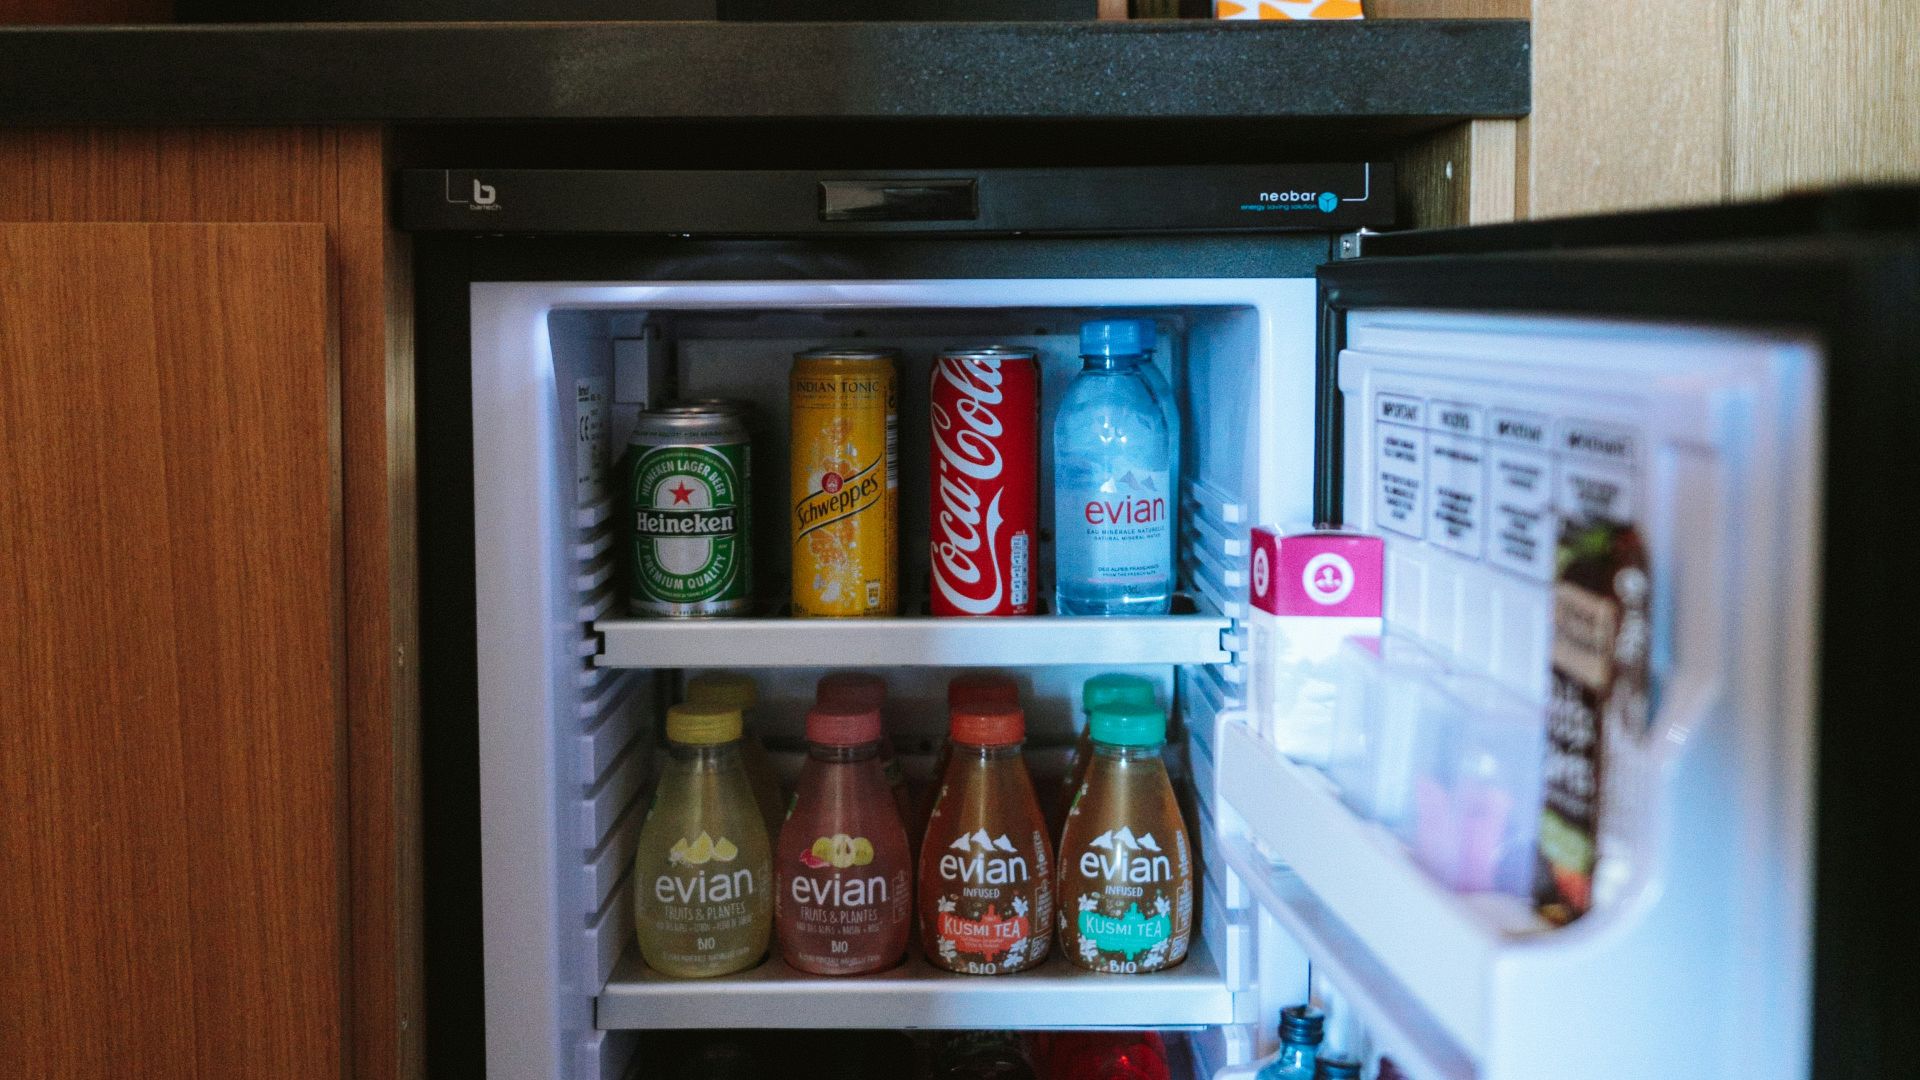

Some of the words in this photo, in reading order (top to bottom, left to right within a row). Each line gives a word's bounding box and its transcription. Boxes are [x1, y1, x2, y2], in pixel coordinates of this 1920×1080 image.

[1240, 204, 1265, 212] energy
[1267, 203, 1290, 212] saving
[1291, 203, 1317, 211] solution
[1260, 190, 1316, 202] neobar
[796, 381, 836, 393] INDIAN
[841, 380, 880, 393] TONIC
[641, 459, 675, 497] HEINEKEN
[677, 459, 712, 476] LAGER
[708, 471, 727, 497] BEER
[931, 357, 1003, 614] Coca-Cola
[796, 472, 879, 530] Schweppes
[1084, 494, 1165, 525] evian
[636, 511, 734, 534] Heineken
[643, 554, 684, 590] PREMIUM
[687, 553, 727, 589] QUALITY
[939, 852, 1028, 884] evian
[1079, 851, 1171, 883] evian
[654, 867, 754, 904] evian
[791, 873, 887, 907] evian
[963, 887, 1000, 899] INFUSED
[1104, 885, 1144, 897] INFUSED
[665, 905, 694, 921] FRUITS
[696, 908, 705, 921] &
[706, 901, 746, 920] PLANTES
[800, 906, 827, 922] FRUITS
[829, 911, 838, 923] &
[839, 907, 878, 923] PLANTES
[944, 915, 990, 937] KUSMI
[993, 920, 1021, 938] TEA
[1086, 915, 1132, 936] KUSMI
[1136, 920, 1162, 938] TEA
[697, 937, 716, 951] BIO
[831, 940, 849, 953] BIO
[968, 961, 997, 975] BIO
[1109, 960, 1138, 974] BIO
